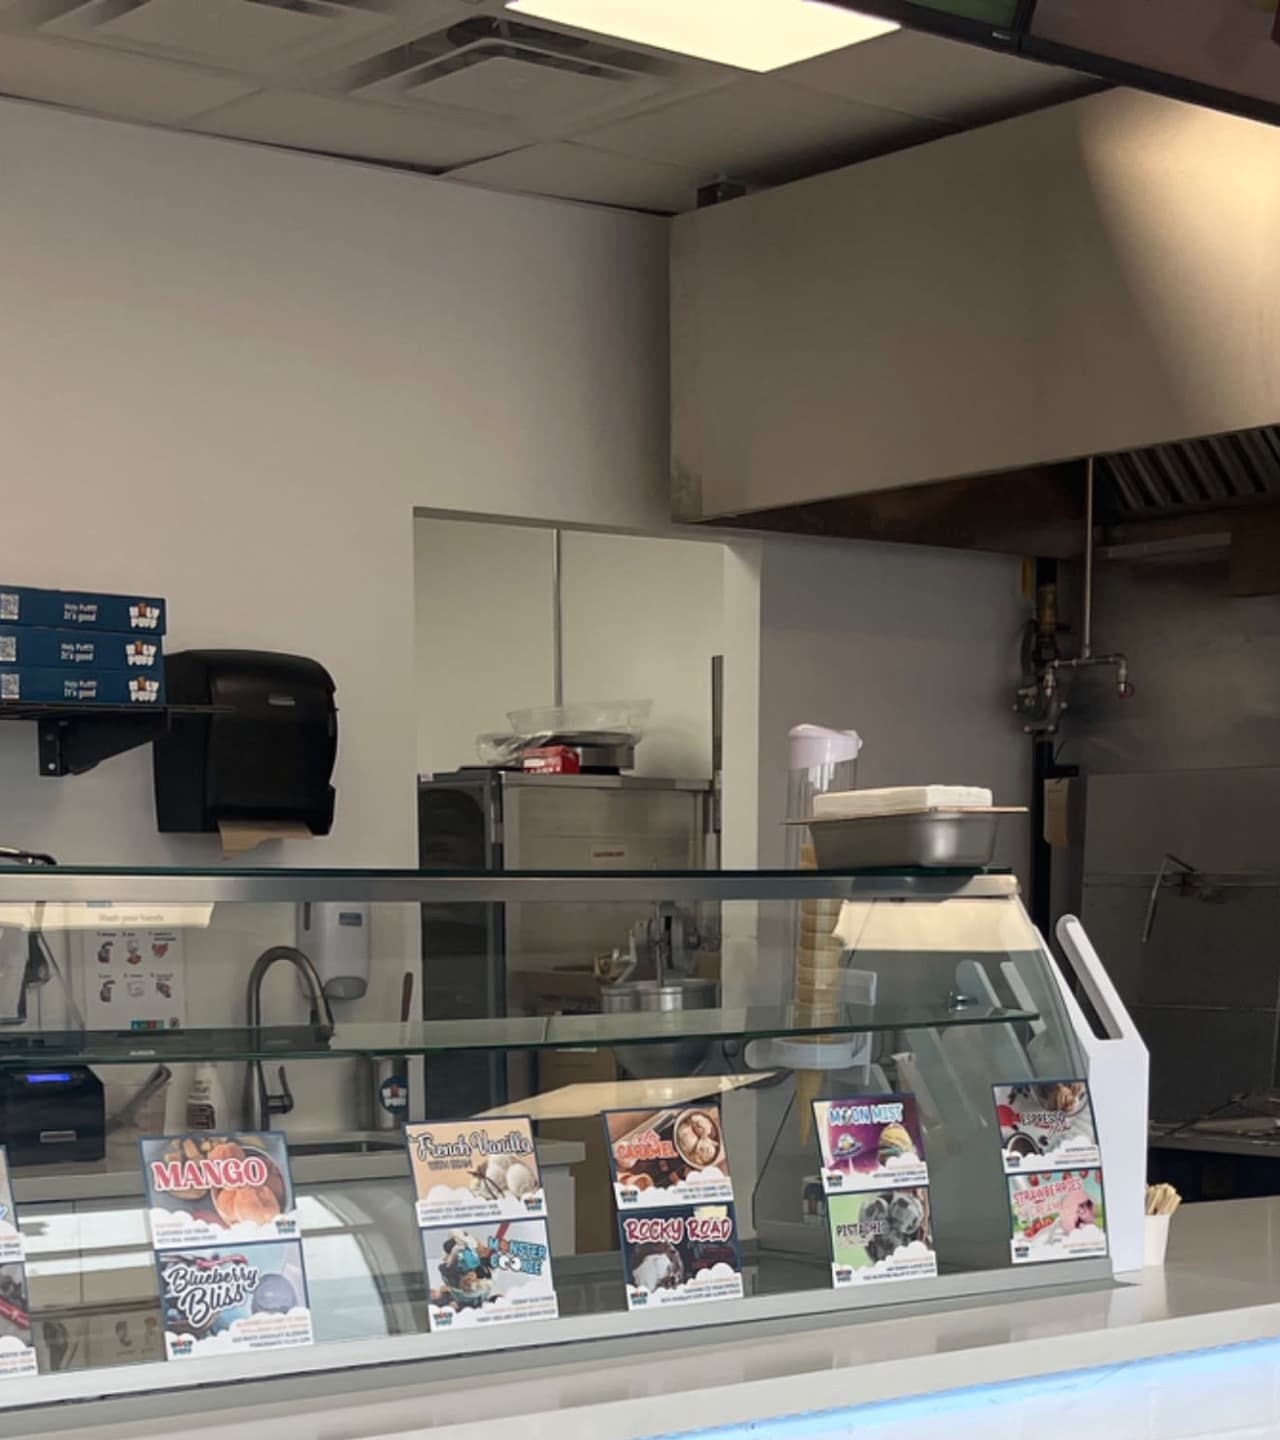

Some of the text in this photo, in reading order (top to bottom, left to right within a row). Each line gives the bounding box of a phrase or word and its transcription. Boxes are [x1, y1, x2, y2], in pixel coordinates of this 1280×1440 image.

[871, 1103, 903, 1123] MIST
[418, 1130, 533, 1160] French Vanilla
[152, 1158, 267, 1190] MANGO
[625, 1217, 732, 1243] ROCKY ROAD
[167, 1266, 258, 1293] Blueberry
[180, 1284, 244, 1324] Bliss
